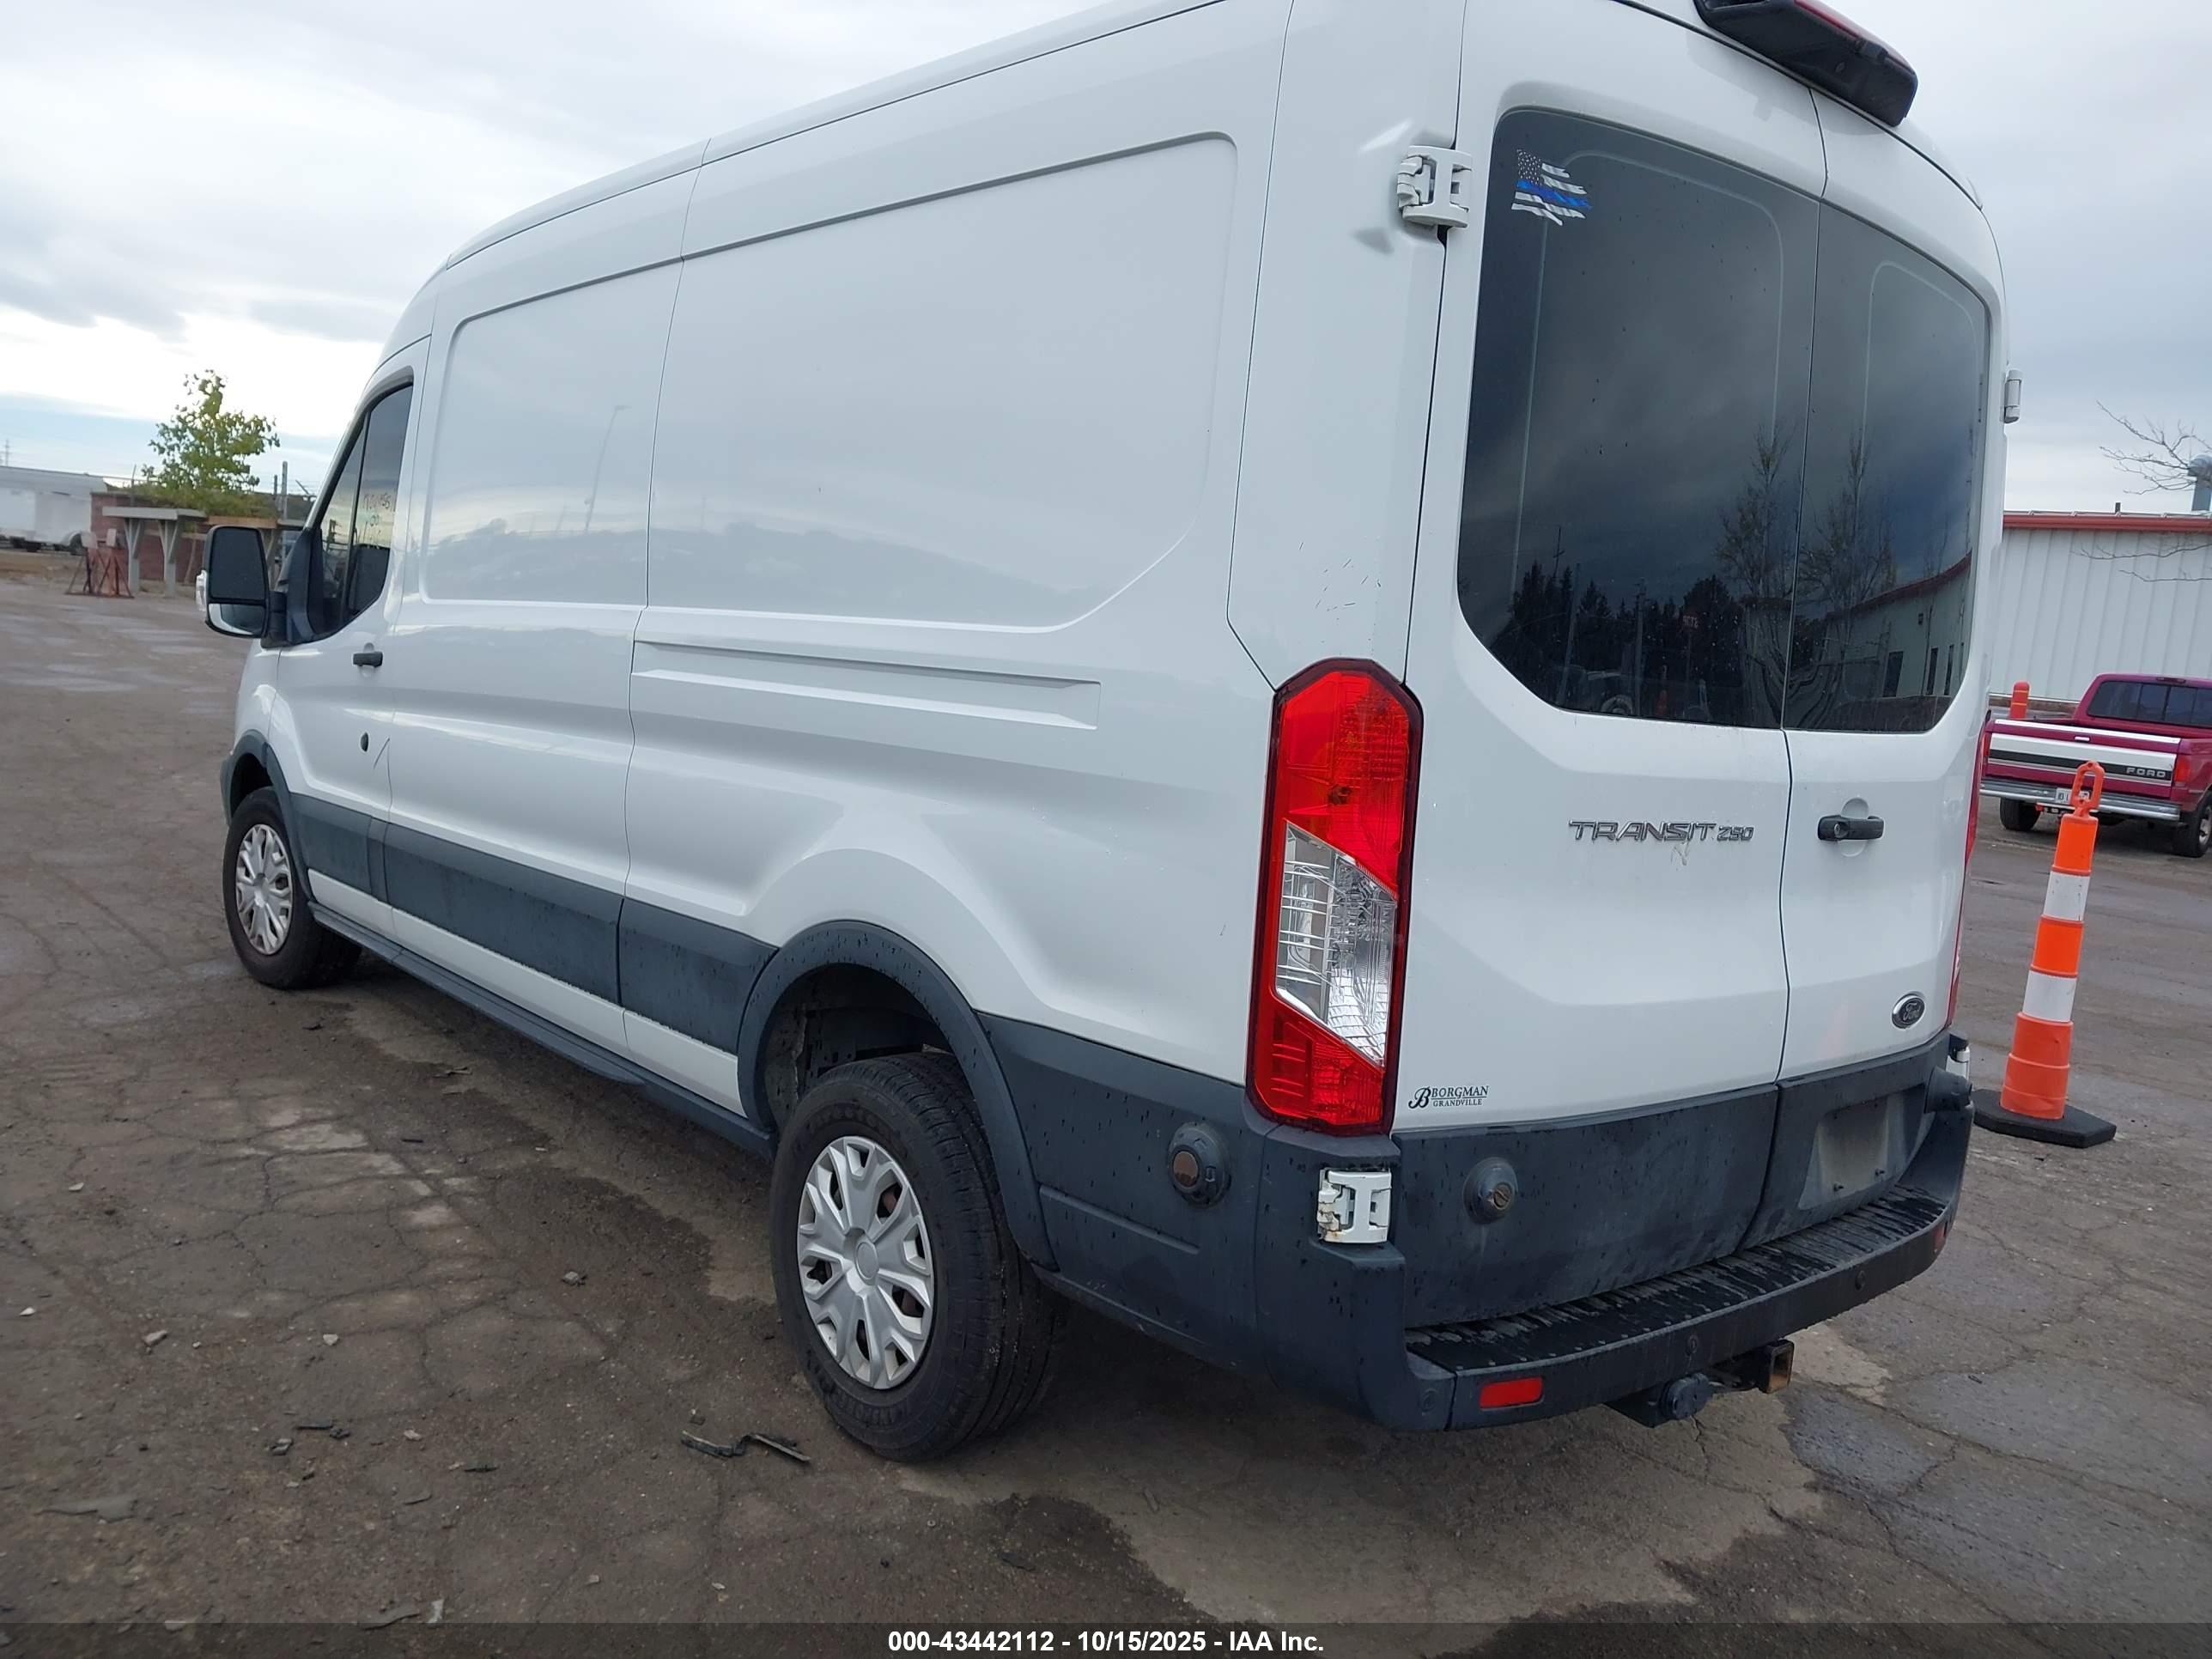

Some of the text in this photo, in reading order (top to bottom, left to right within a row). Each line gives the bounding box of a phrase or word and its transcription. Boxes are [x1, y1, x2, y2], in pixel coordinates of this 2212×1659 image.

[2126, 767, 2166, 778] FORD
[1568, 820, 1754, 842] TRANSIT 250
[1431, 1085, 1489, 1098] BORGMAN
[1432, 1099, 1483, 1108] GRANDVILLE
